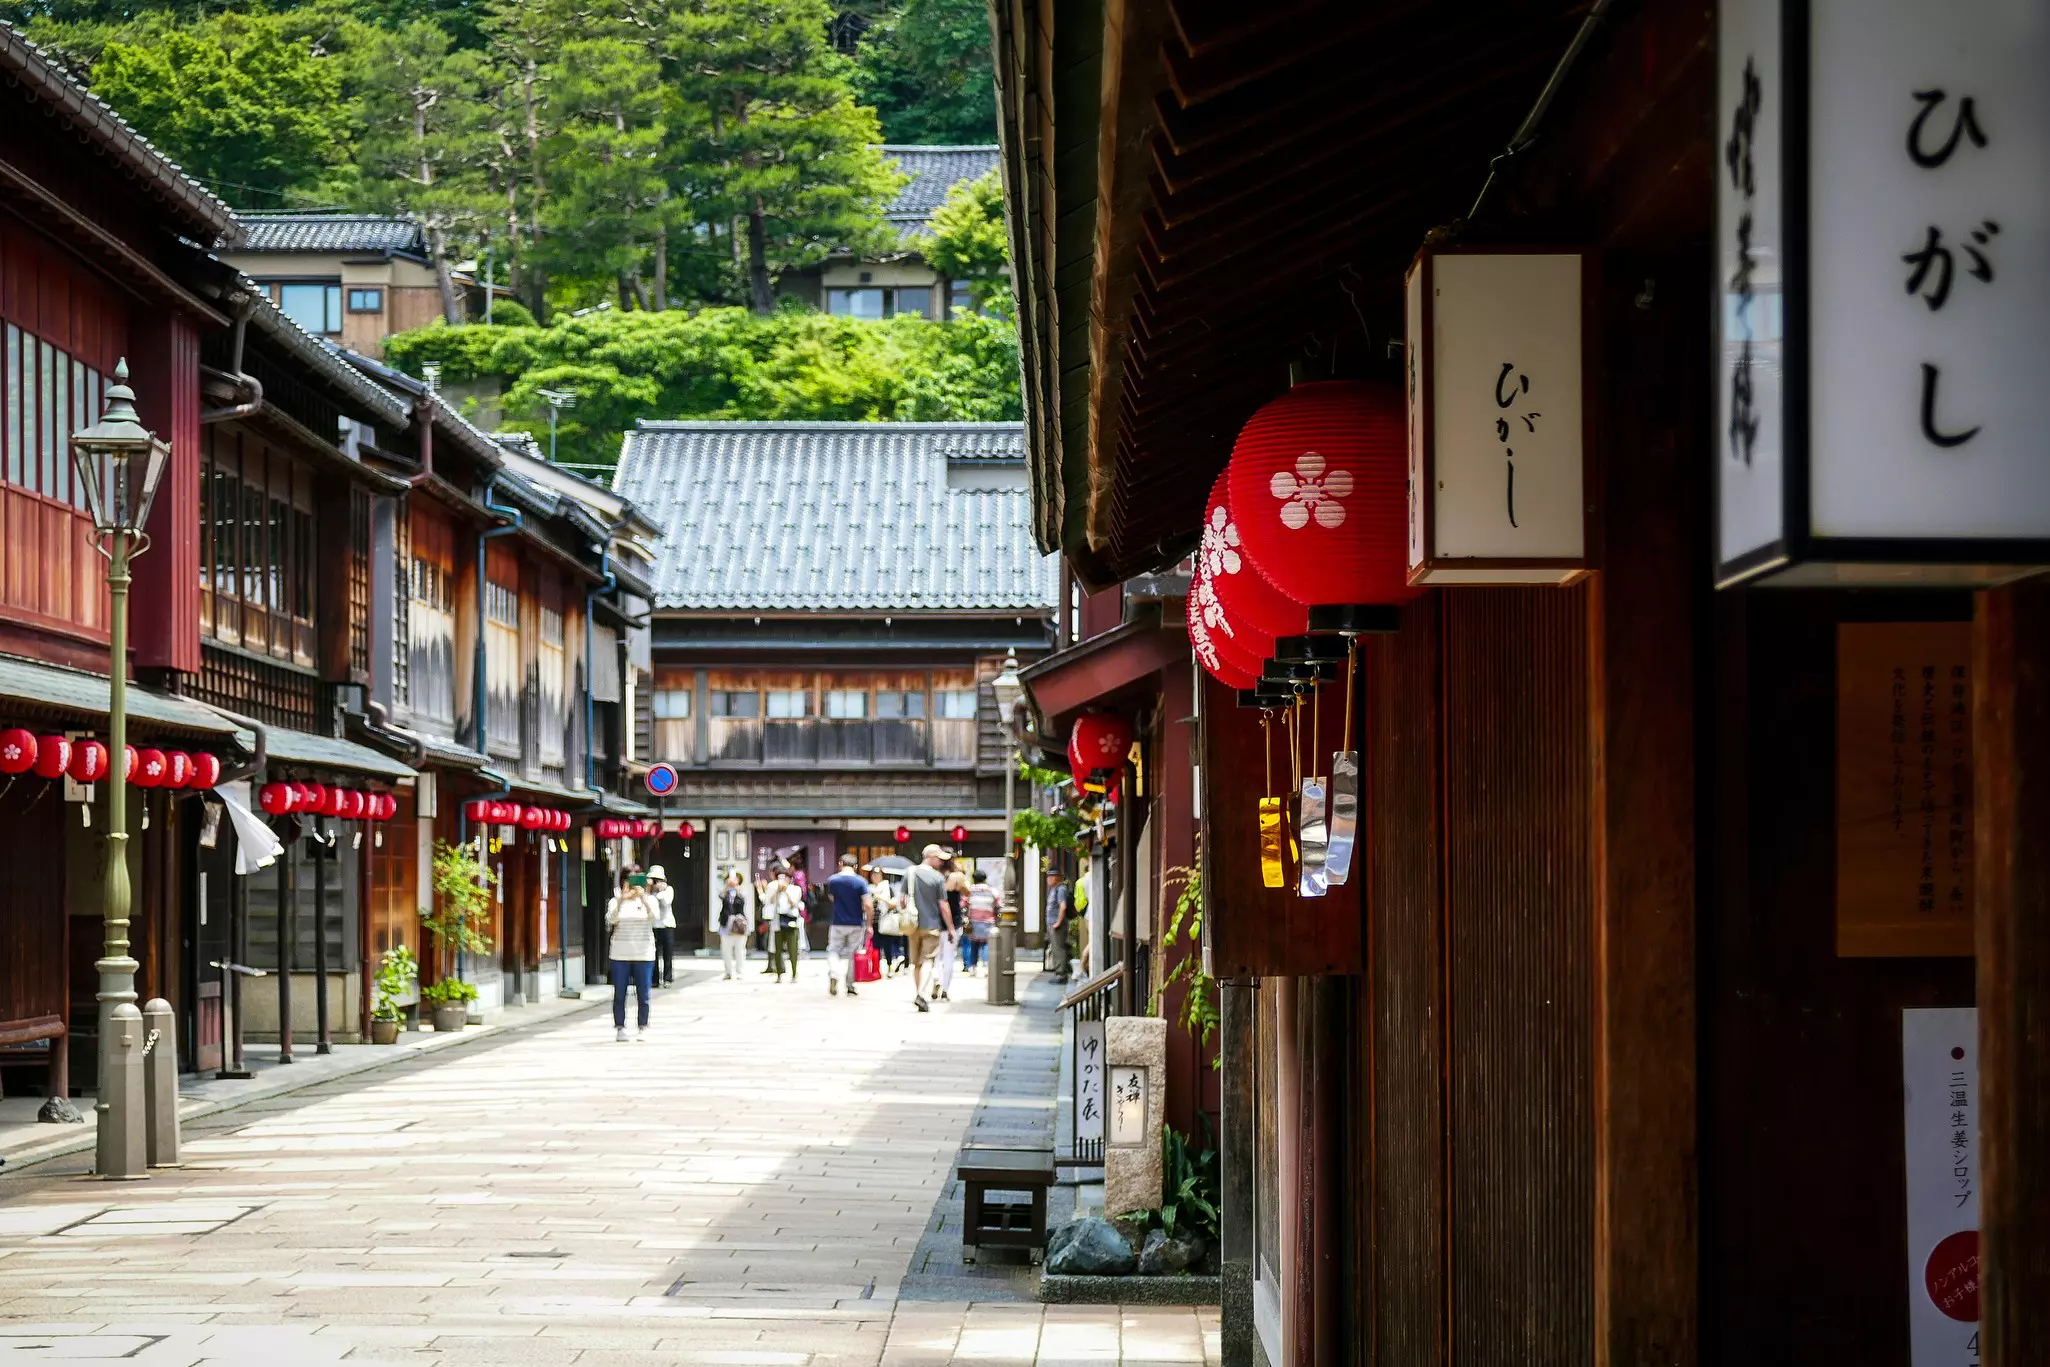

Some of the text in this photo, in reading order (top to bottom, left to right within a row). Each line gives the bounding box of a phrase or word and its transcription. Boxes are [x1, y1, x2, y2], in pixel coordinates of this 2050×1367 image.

[1902, 87, 2001, 449] ひがし
[1495, 361, 1542, 529] ひがし
[1949, 1071, 1971, 1209] 三温生姜シロップ
[1943, 1274, 1981, 1309] お子様
